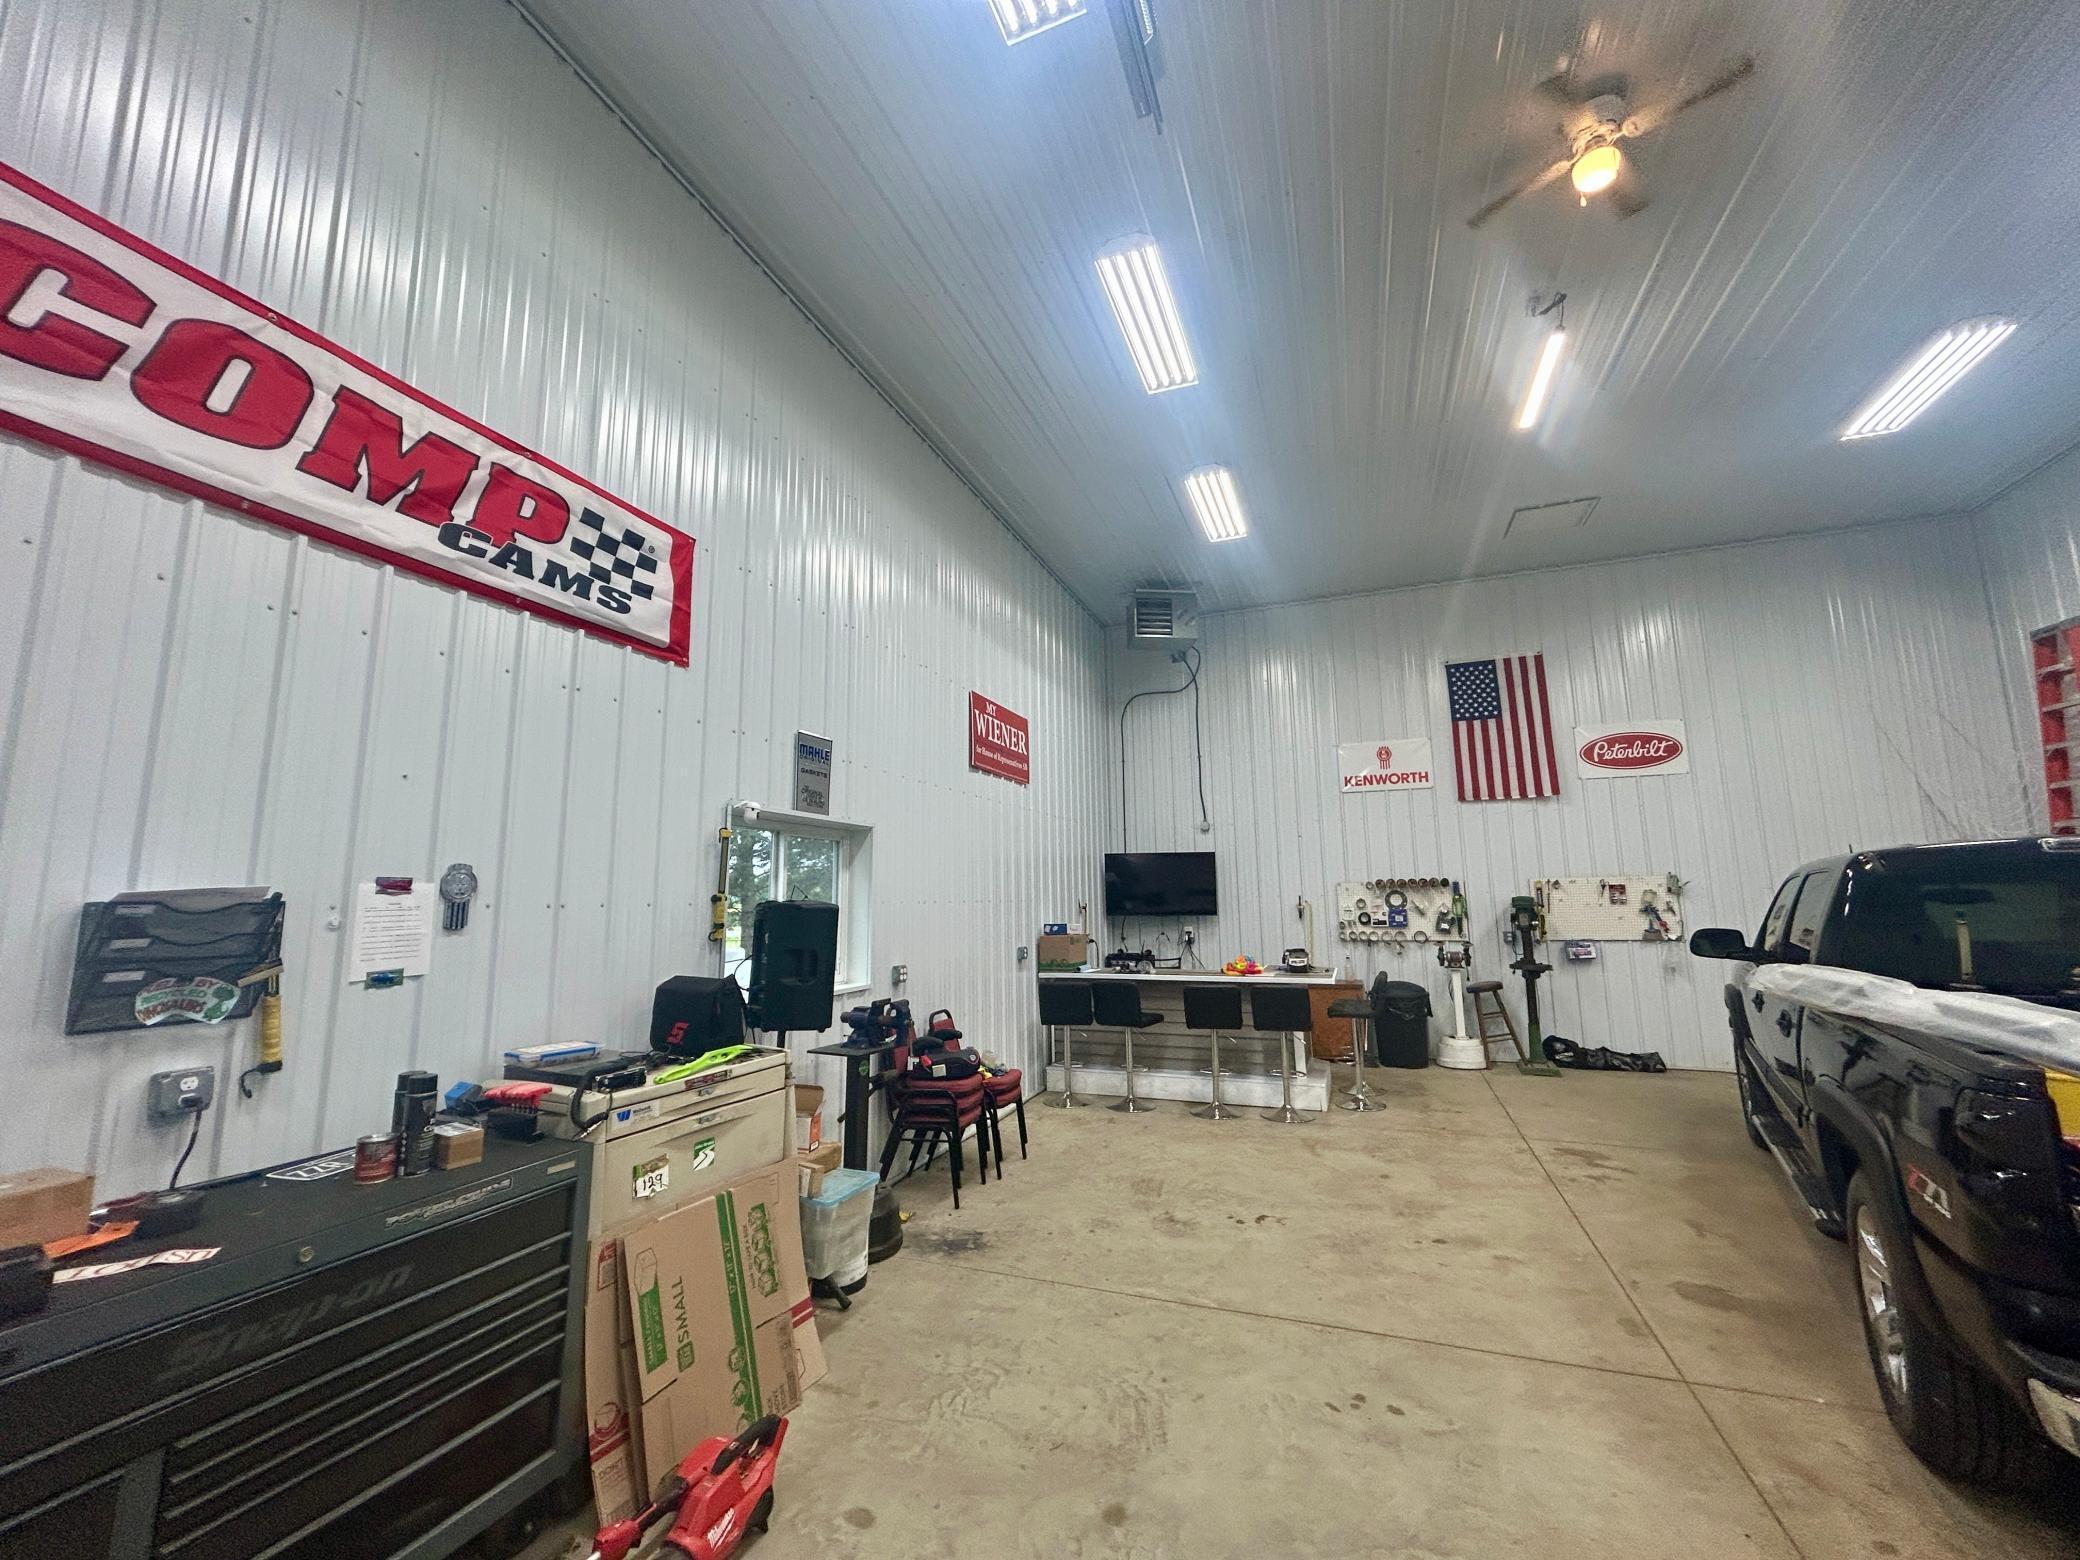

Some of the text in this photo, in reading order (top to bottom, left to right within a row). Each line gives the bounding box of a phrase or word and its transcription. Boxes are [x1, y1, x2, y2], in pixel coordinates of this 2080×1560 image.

[0, 217, 572, 546] COMP
[437, 521, 633, 615] CAMS
[985, 702, 997, 717] MY
[974, 709, 1028, 755] WIENER
[800, 744, 830, 761] MAHLE
[1593, 740, 1674, 762] Peterbilt
[1344, 771, 1429, 787] KENWORTH
[671, 1275, 690, 1344] SMALL
